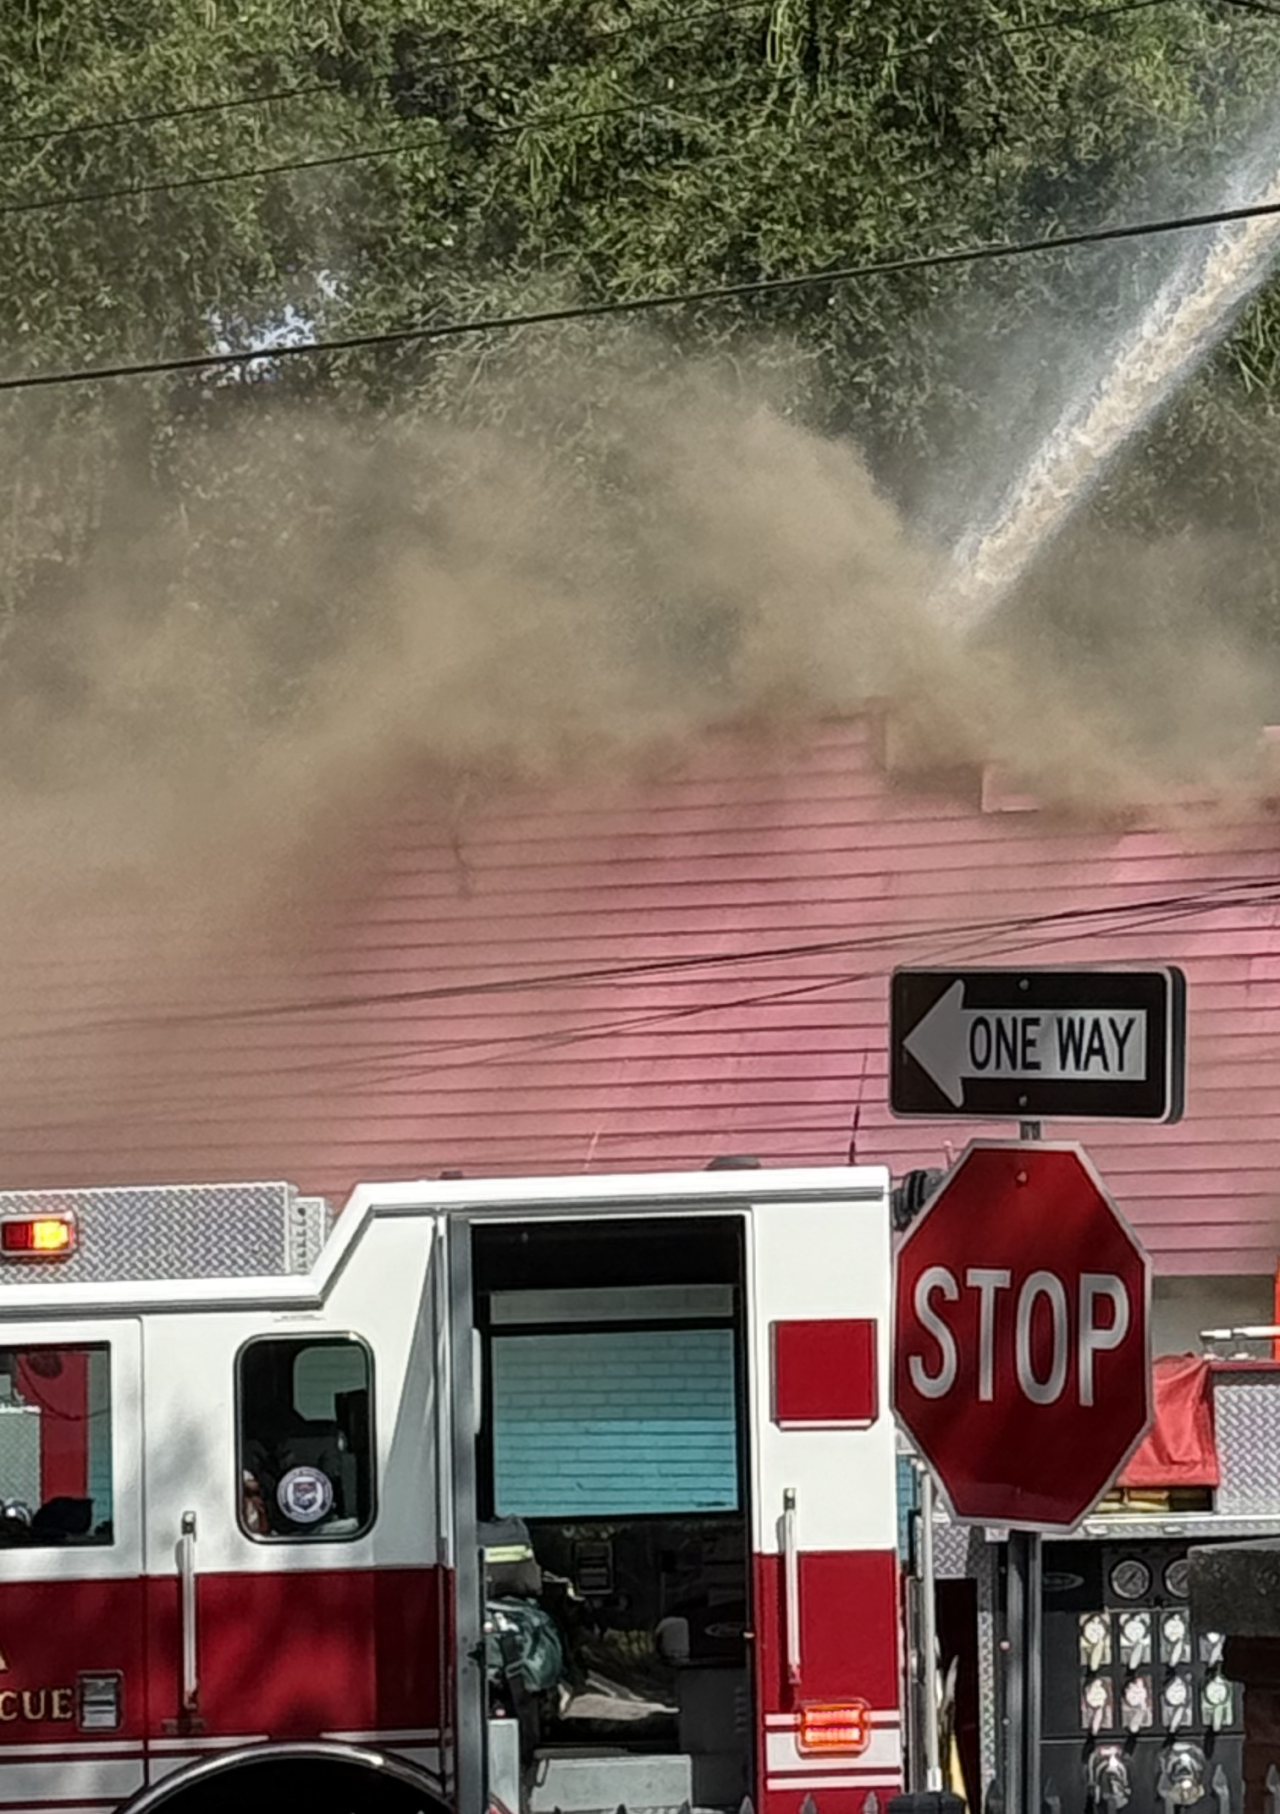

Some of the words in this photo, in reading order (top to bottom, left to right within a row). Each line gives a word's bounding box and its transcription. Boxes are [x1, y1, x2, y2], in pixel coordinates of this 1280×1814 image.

[969, 1016, 1041, 1071] ONE
[1056, 1016, 1136, 1072] WAY
[909, 1265, 1130, 1407] STOP
